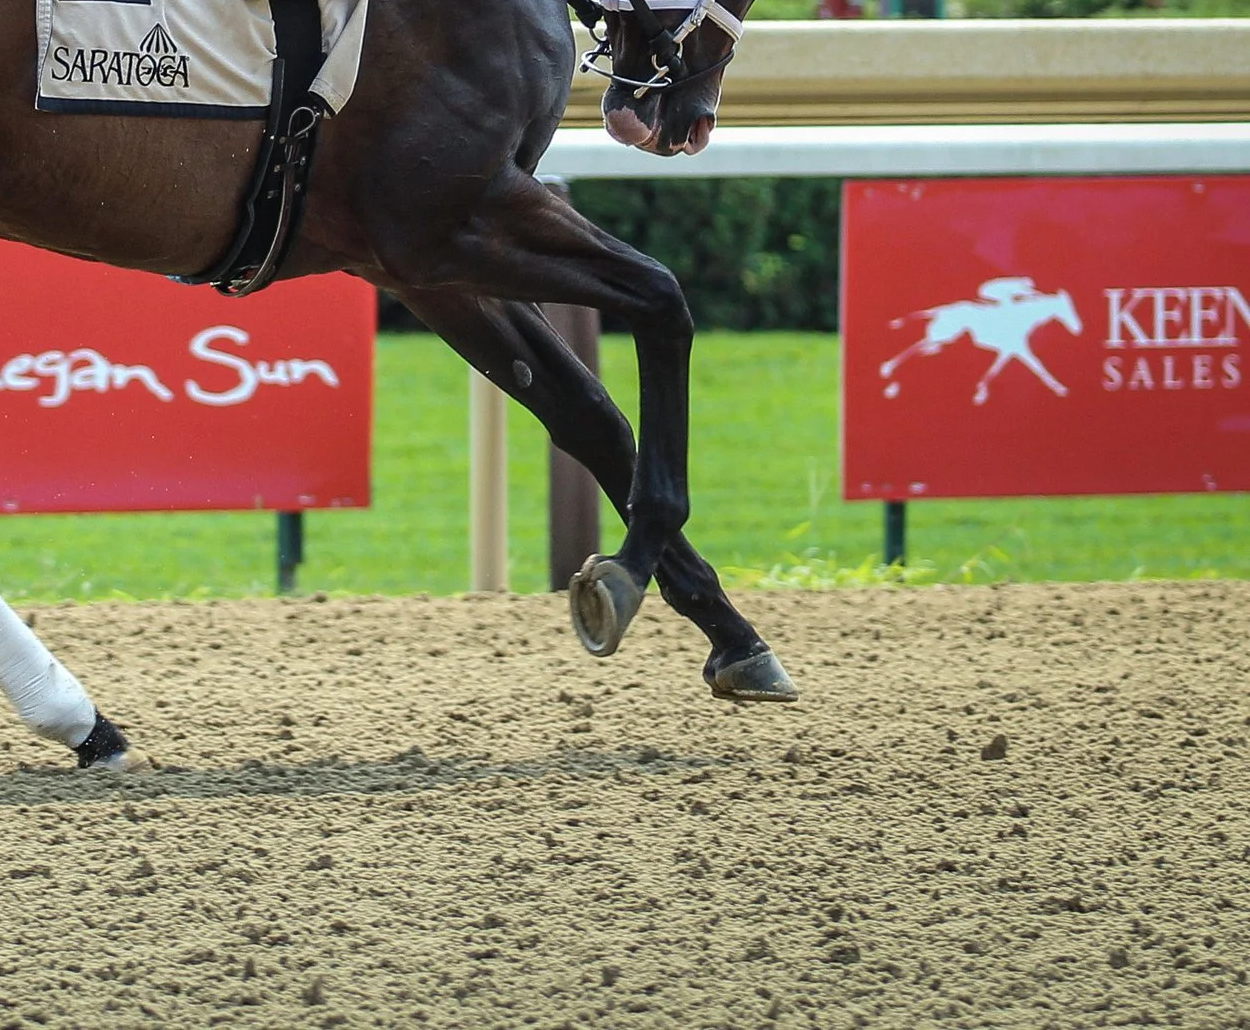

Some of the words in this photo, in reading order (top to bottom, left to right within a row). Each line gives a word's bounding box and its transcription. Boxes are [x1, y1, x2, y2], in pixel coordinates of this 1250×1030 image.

[51, 46, 190, 88] SARATOGA
[184, 324, 340, 407] Sun
[1101, 354, 1242, 391] SALES
